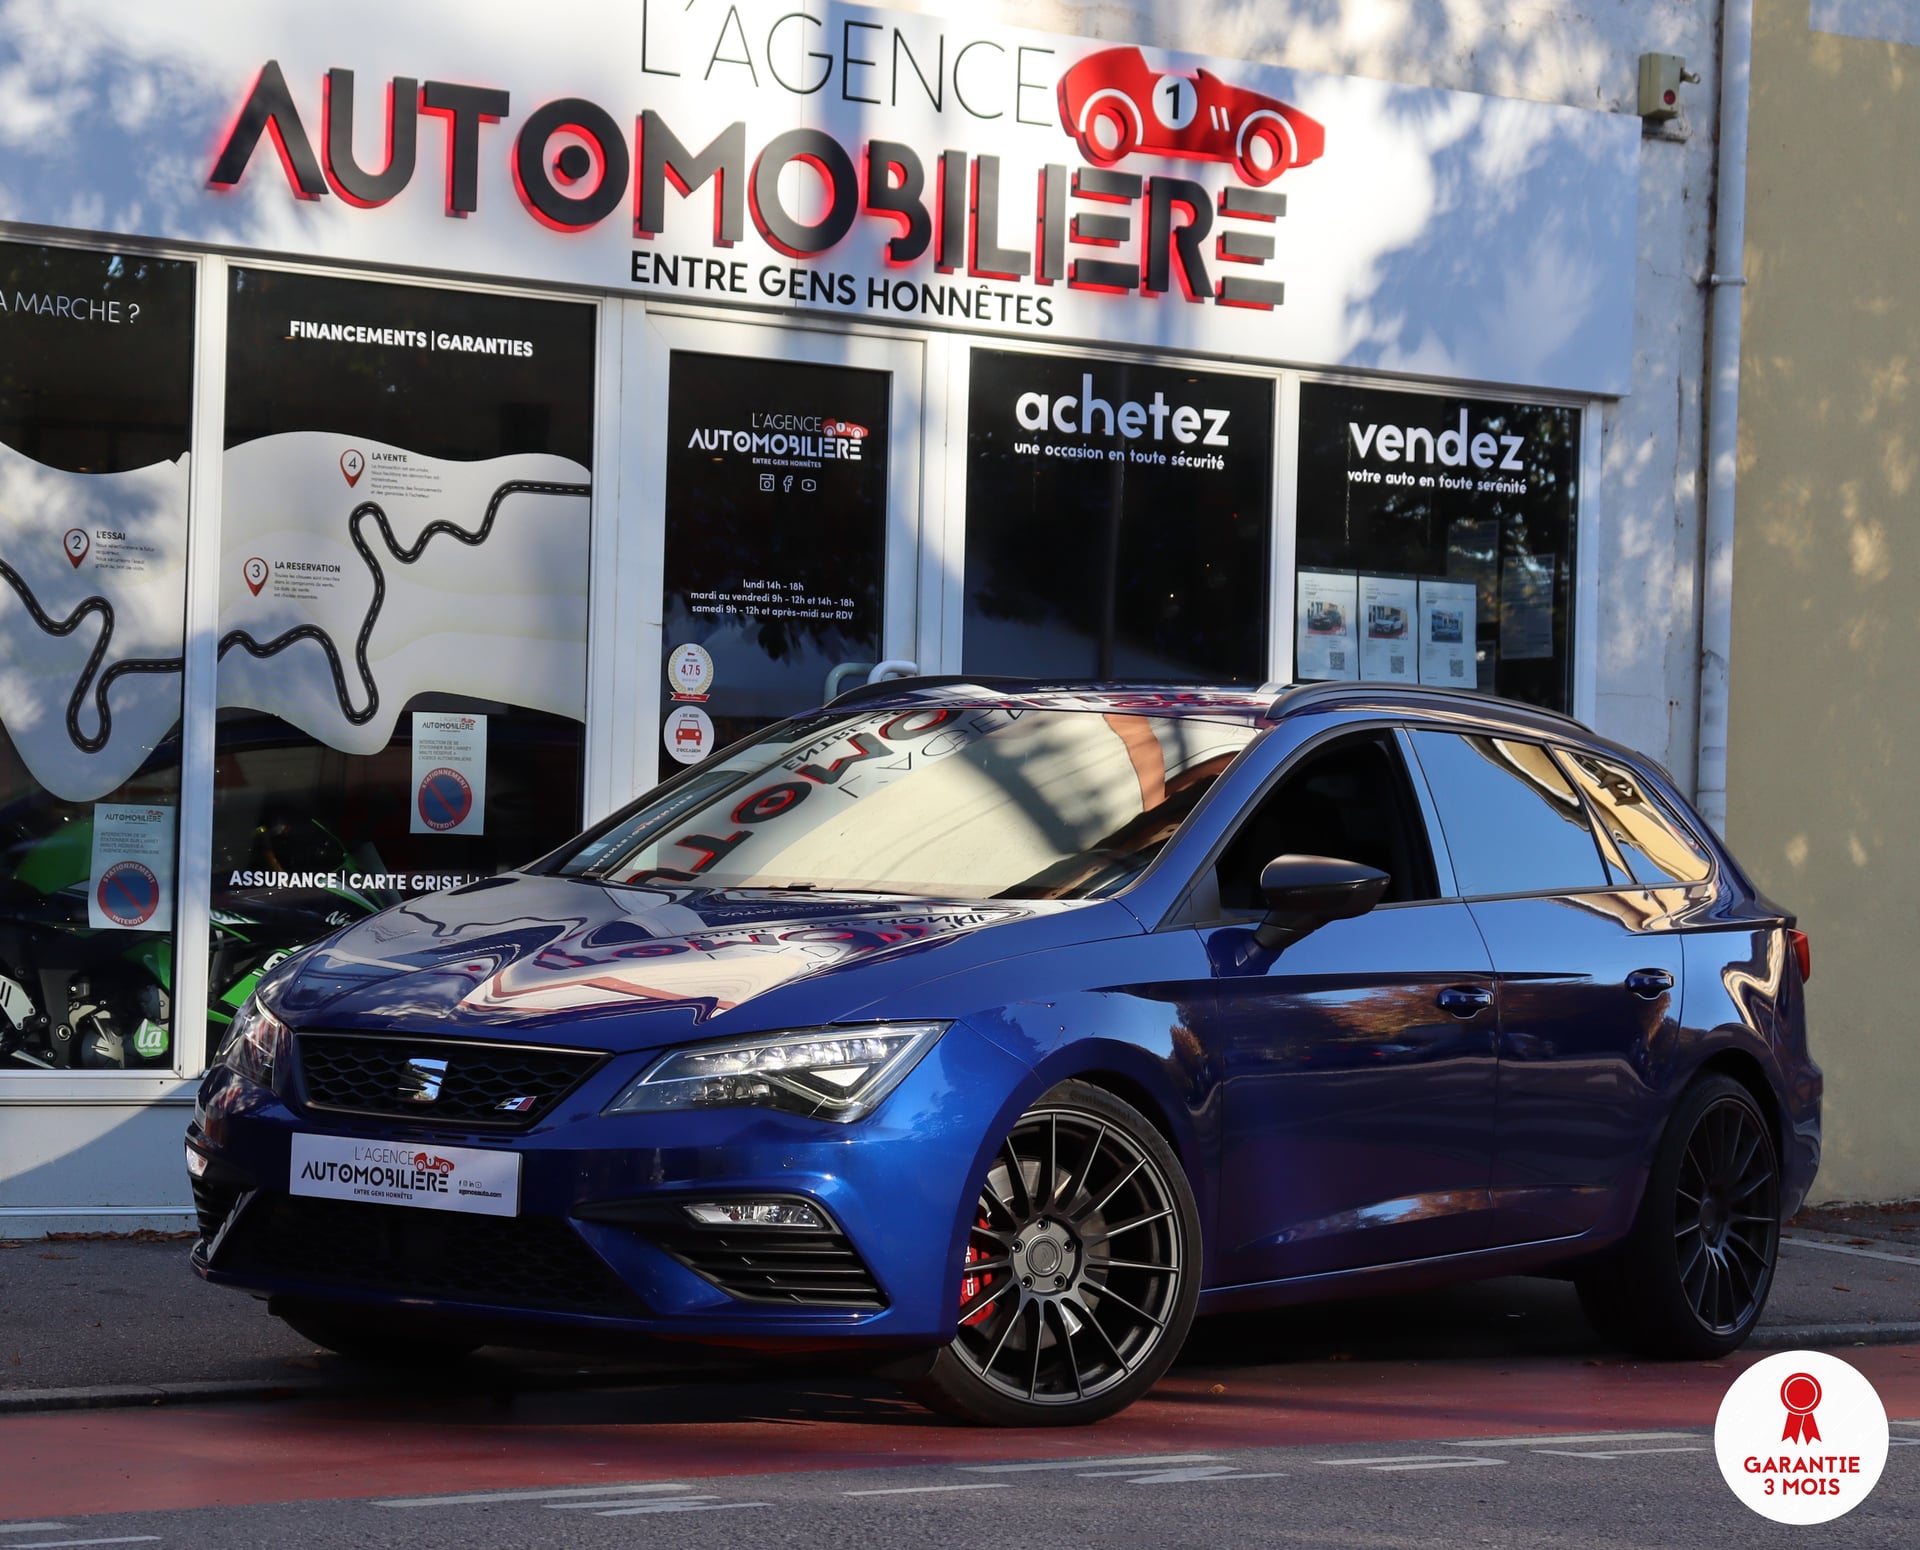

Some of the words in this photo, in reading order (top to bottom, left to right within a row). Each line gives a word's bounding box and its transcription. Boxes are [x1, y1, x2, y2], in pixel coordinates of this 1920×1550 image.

[641, 0, 1055, 127] L'AGENCE
[630, 251, 748, 293] ENTRE
[759, 264, 857, 305] GENS
[867, 279, 1054, 327] HONNÊTES
[14, 291, 121, 323] MARCHE
[290, 320, 427, 348] FINANCEMENTS
[437, 333, 533, 357] GARANTIES
[1015, 373, 1231, 447] achetez
[752, 412, 822, 433] L'AGENCE
[1349, 408, 1525, 471] vendez
[348, 457, 357, 469] 4
[371, 452, 381, 461] LA
[383, 453, 407, 462] VENTE
[752, 457, 772, 465] ENTRE
[773, 458, 789, 466] GENS
[789, 459, 822, 468] HONNÊTES
[1014, 441, 1040, 454] une
[1045, 442, 1103, 460] occasion
[1108, 451, 1125, 461] en
[1130, 449, 1167, 464] toute
[1171, 450, 1225, 471] sécurité
[1347, 469, 1381, 483] votre
[1385, 472, 1415, 486] auto
[1419, 475, 1435, 487] en
[1439, 474, 1473, 490] toute
[73, 535, 82, 549] 2
[96, 530, 126, 540] L'ESSAI
[252, 564, 261, 578] 3
[275, 561, 284, 569] LA
[286, 562, 340, 573] RESERVATION
[743, 579, 765, 589] lundi
[766, 580, 781, 590] 14h
[789, 582, 804, 591] 18h
[690, 590, 717, 600] mardi
[719, 593, 730, 601] au
[732, 592, 770, 602] vendredi
[772, 593, 783, 603] 9h
[791, 595, 805, 604] 12h
[807, 596, 816, 604] et
[818, 597, 832, 606] 14h
[840, 598, 854, 607] 18h
[692, 603, 724, 613] samedi
[726, 604, 737, 614] 9h
[746, 606, 760, 615] 12h
[761, 606, 770, 615] et
[772, 607, 819, 619] après-midi
[820, 611, 834, 619] sur
[836, 610, 853, 620] RDV
[422, 769, 468, 790] STATIONNEMENT
[427, 819, 456, 829] INTERDIT
[103, 862, 156, 883] STATIONNEMENT
[229, 870, 337, 889] ASSURANCE
[350, 873, 407, 891] CARTE
[411, 875, 463, 892] GRISE
[112, 914, 144, 925] INTERDIT
[354, 1146, 415, 1166] L'AGENCE
[353, 1188, 370, 1196] ENTRE
[371, 1190, 385, 1198] GENS
[386, 1190, 413, 1200] HONNÊTES
